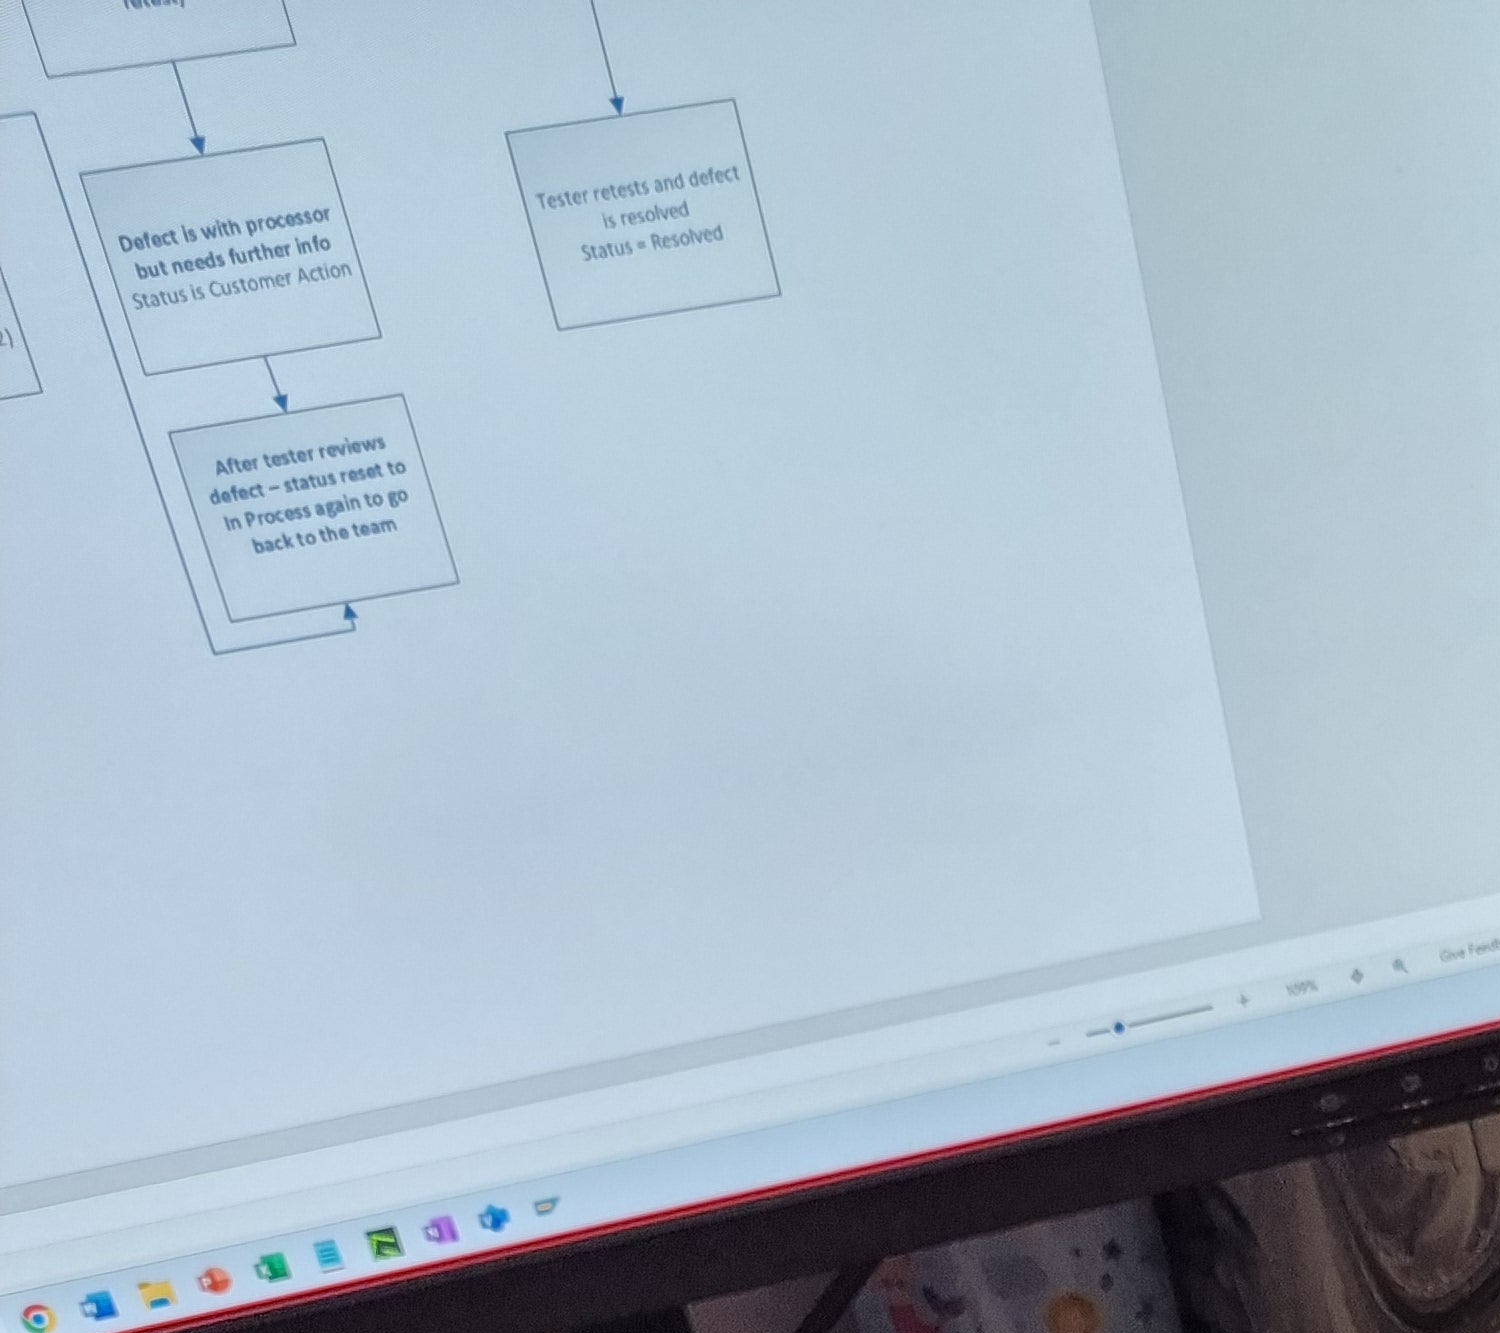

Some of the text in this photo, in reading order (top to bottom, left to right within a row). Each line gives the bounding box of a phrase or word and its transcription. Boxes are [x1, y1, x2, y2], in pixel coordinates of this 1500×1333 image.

[535, 165, 741, 210] Tester retests and defect
[118, 206, 330, 253] Defect is with processor
[602, 200, 690, 229] is resolved
[135, 235, 332, 280] but needs further info
[581, 241, 633, 262] Status
[650, 224, 724, 251] Resolved
[132, 261, 353, 310] Status is Customer Action
[215, 436, 387, 476] After tester reviews
[209, 483, 265, 505] defect
[284, 472, 337, 493] status
[340, 464, 384, 483] reset
[387, 460, 407, 475] to
[223, 489, 409, 532] In Process again to go
[252, 518, 397, 554] back to the team
